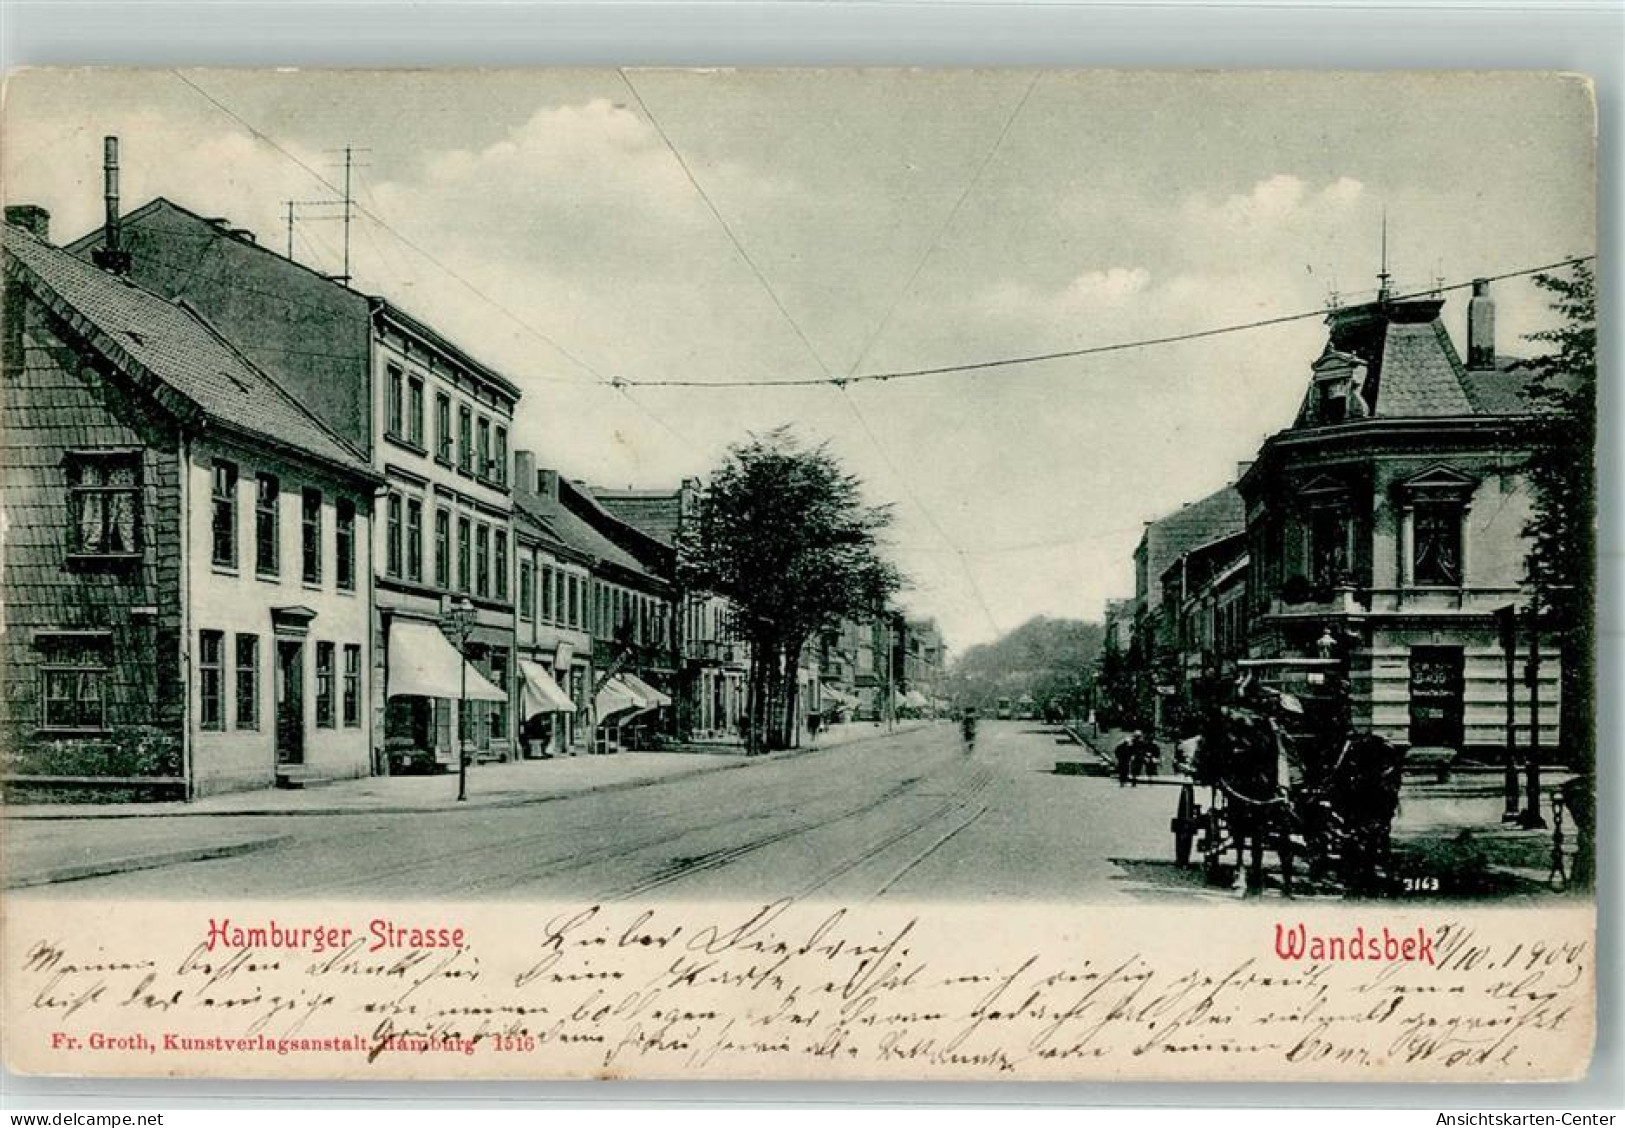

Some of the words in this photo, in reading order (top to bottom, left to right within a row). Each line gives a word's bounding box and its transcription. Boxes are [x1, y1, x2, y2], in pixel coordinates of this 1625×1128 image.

[206, 917, 350, 952] Hamburger
[1274, 922, 1435, 961] Wandsbek
[51, 1032, 83, 1050] Fr.
[89, 1032, 156, 1053] Groth,
[492, 1035, 535, 1052] 1516
